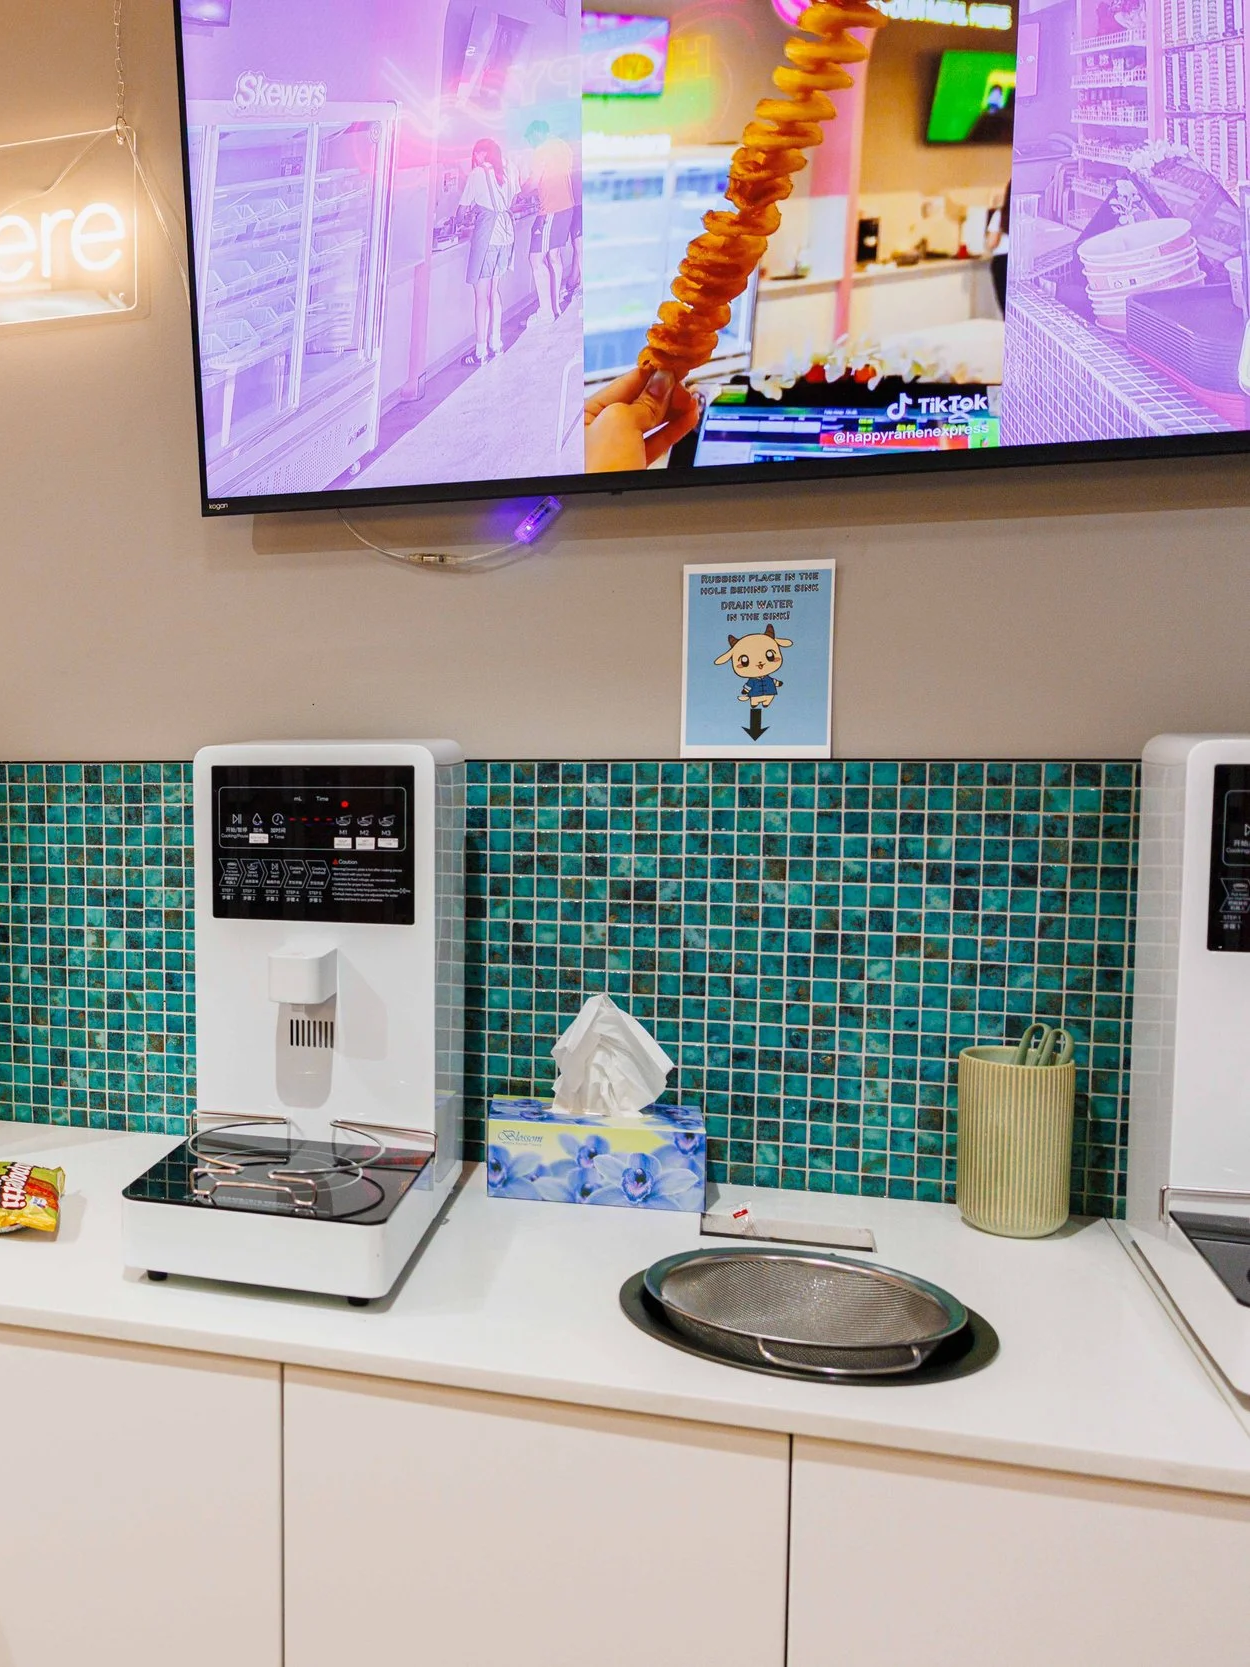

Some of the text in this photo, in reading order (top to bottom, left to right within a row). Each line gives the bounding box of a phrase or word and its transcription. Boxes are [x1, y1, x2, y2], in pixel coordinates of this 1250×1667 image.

[235, 72, 325, 107] Skewers
[917, 393, 988, 415] TikTok
[833, 423, 989, 444] @happyramenexpress
[208, 503, 229, 511] kogan
[749, 573, 782, 582] PLACE
[784, 572, 796, 581] IN
[798, 572, 819, 581] THE
[700, 583, 819, 595] HOLE BEHIND THE SINK
[721, 599, 794, 610] DRAIN WATER
[726, 611, 790, 621] IN THE SINK!
[497, 1129, 543, 1143] Blossom
